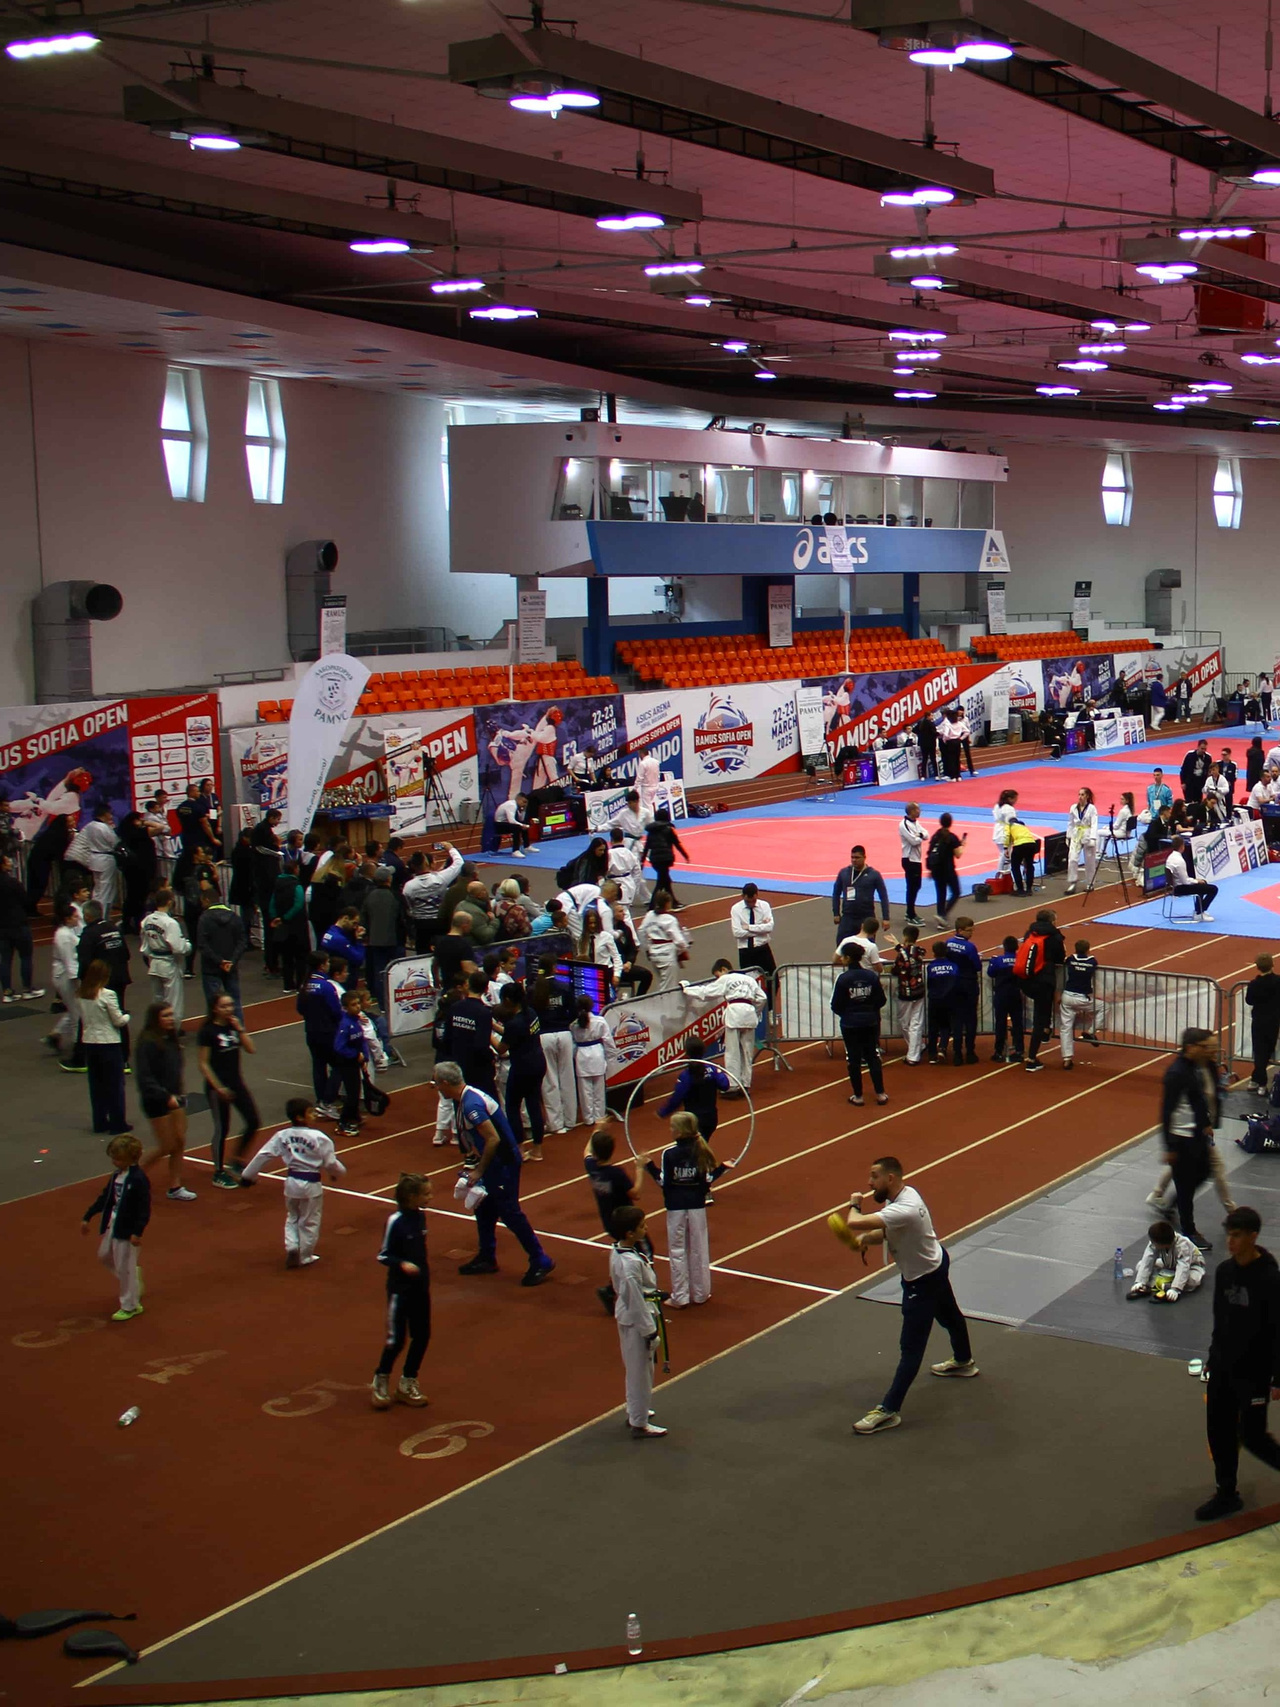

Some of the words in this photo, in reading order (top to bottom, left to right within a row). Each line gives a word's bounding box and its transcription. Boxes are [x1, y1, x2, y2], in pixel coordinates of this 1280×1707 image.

[817, 536, 869, 564] acs
[1200, 656, 1219, 681] OPEN
[800, 706, 823, 716] РАМУС
[882, 690, 923, 731] SOFIA
[924, 667, 959, 705] OPEN
[313, 708, 349, 725] РАМУС
[592, 704, 615, 727] 22-23
[636, 708, 653, 726] ASICS
[653, 700, 671, 716] ARENA
[773, 700, 795, 724] 22-23
[27, 724, 80, 760] SOFIA
[83, 703, 129, 737] OPEN
[591, 717, 617, 741] MARCH
[629, 734, 650, 751] RAMUS
[650, 727, 666, 740] SOFIA
[666, 717, 681, 732] OPEN
[695, 733, 718, 746] RAMUS
[717, 731, 736, 744] SOFIA
[736, 729, 752, 742] OPEN
[771, 715, 798, 740] MARCH
[563, 740, 578, 767] E3
[597, 734, 614, 751] 2025
[777, 732, 793, 751] 2025
[849, 771, 854, 779] 0
[863, 769, 868, 777] 0
[395, 990, 413, 998] RAMUS
[413, 988, 427, 997] SOFIA
[701, 1005, 727, 1037] SOF
[625, 1035, 638, 1044] SOFIA
[637, 1031, 649, 1042] OPEN
[673, 1166, 697, 1178] SAMSO
[10, 1315, 108, 1349] 3
[137, 1348, 229, 1385] 4
[260, 1378, 374, 1418] 5
[399, 1419, 496, 1460] 6
